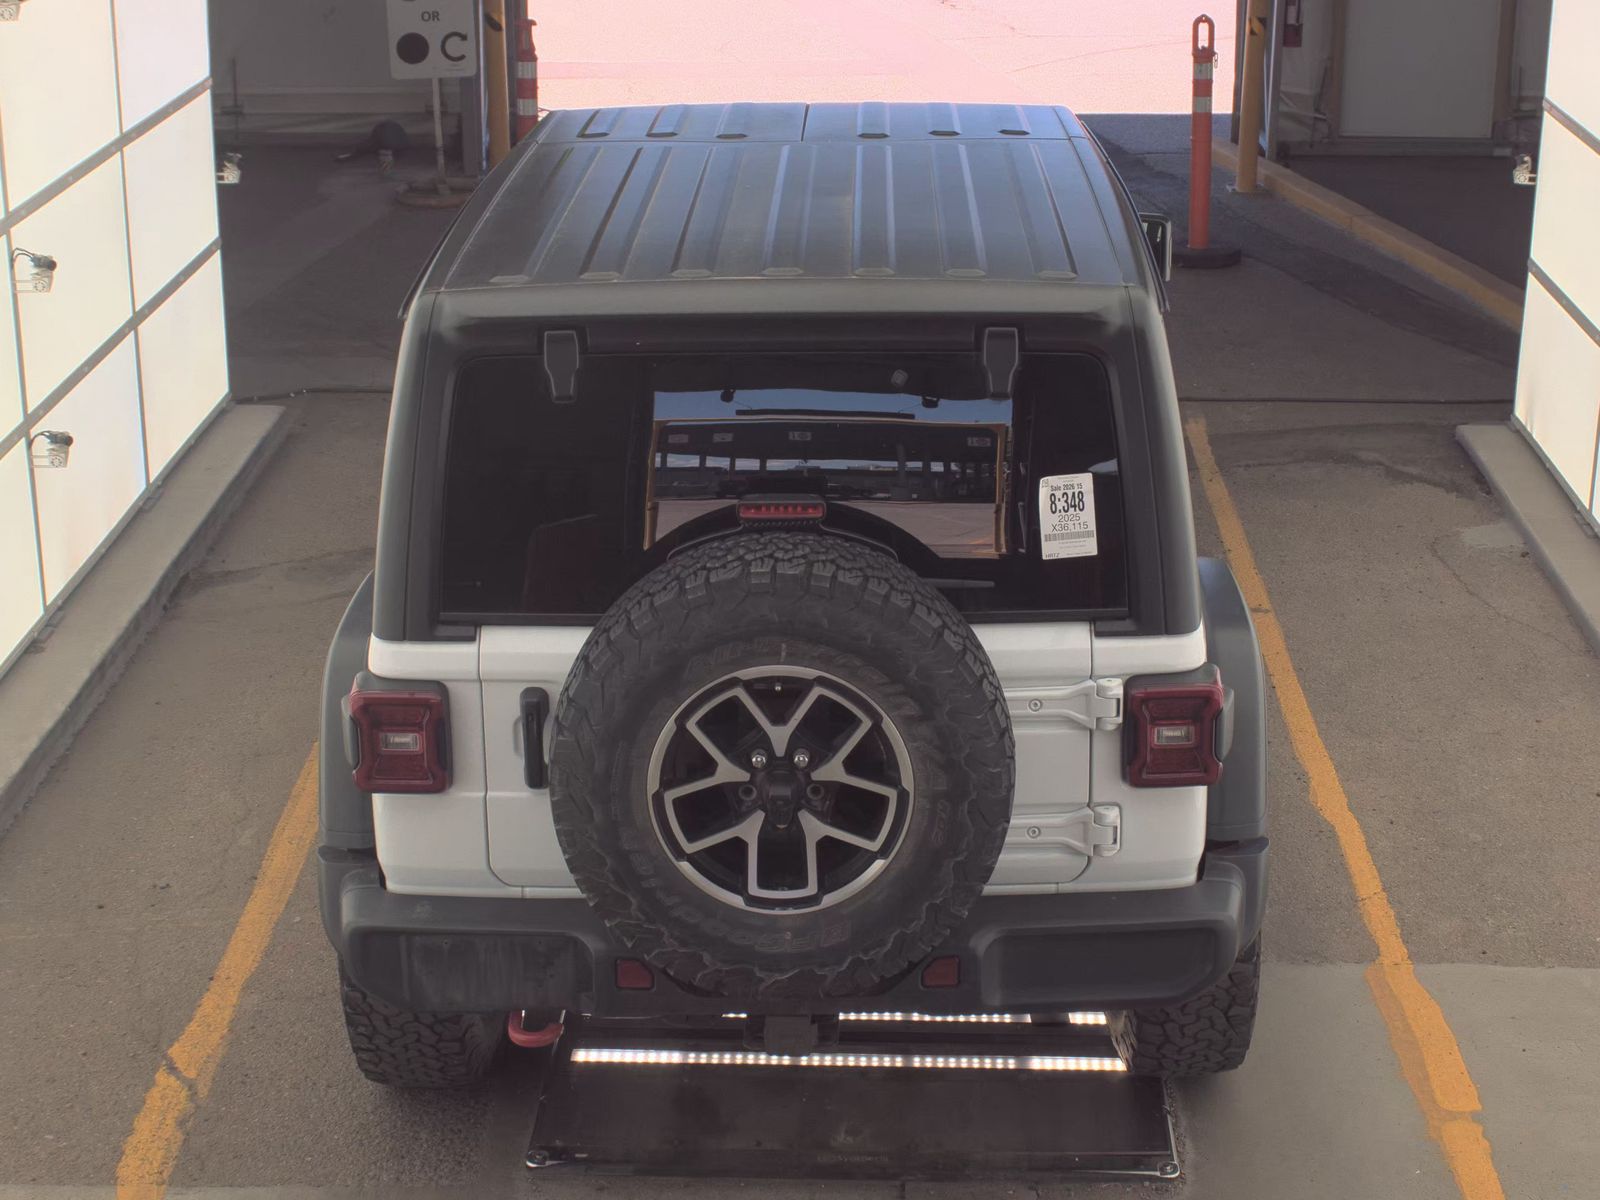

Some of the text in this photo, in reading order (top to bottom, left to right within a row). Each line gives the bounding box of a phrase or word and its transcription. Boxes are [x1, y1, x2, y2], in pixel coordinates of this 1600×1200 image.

[421, 10, 440, 22] OR
[1050, 484, 1062, 492] Sale
[1058, 513, 1080, 522] 2025
